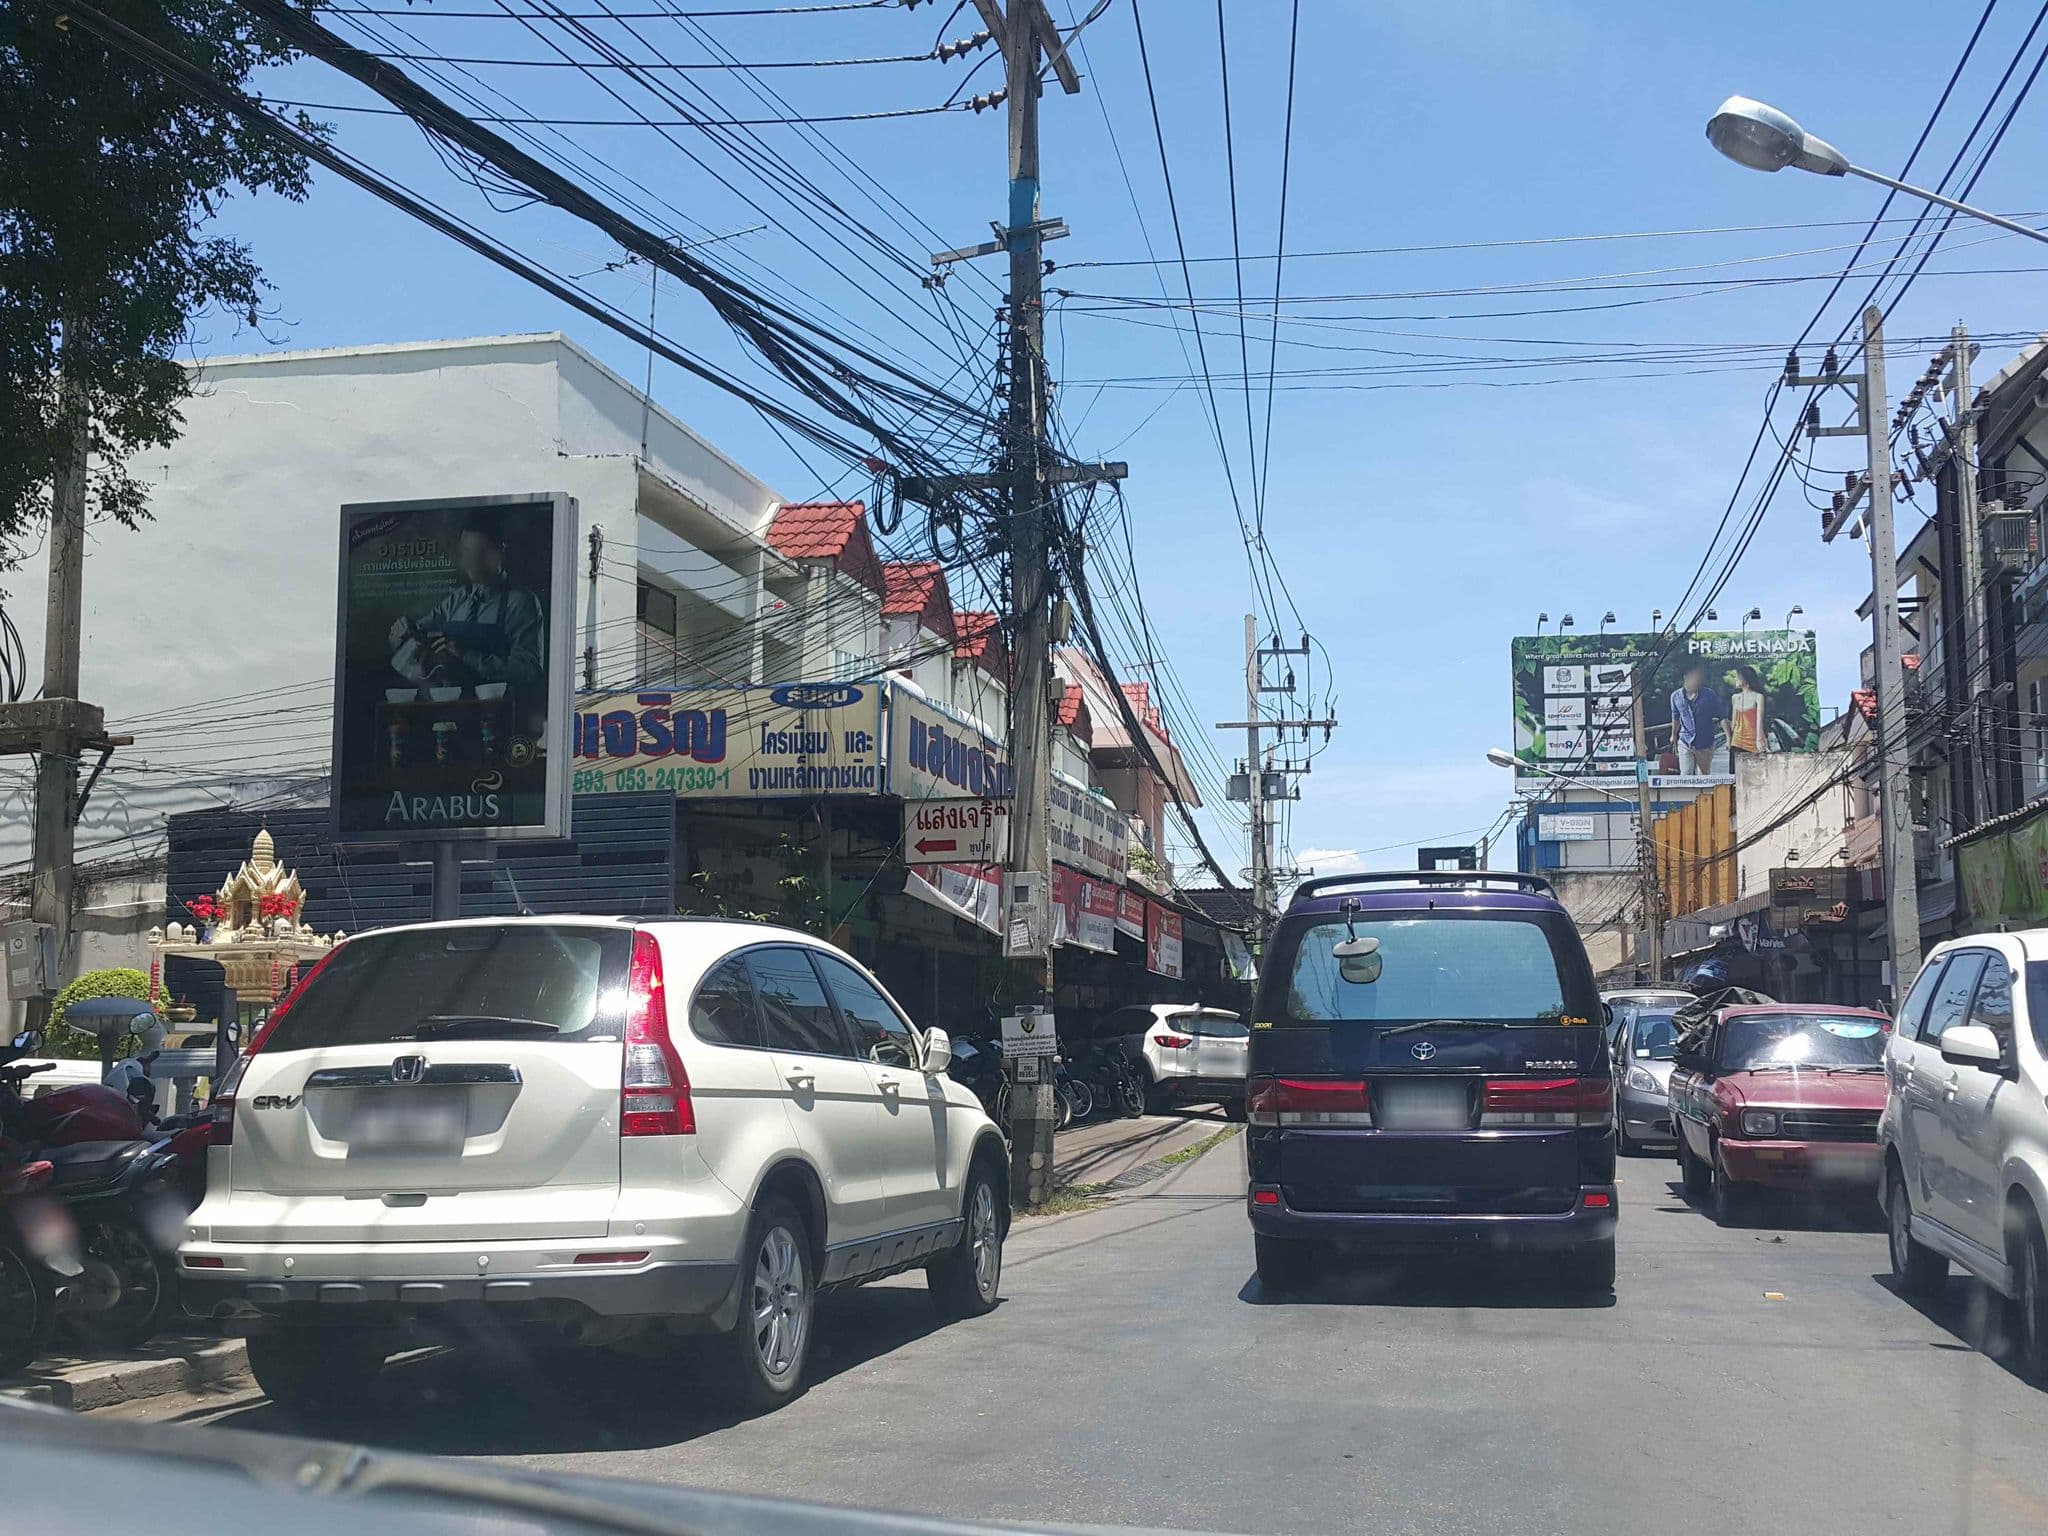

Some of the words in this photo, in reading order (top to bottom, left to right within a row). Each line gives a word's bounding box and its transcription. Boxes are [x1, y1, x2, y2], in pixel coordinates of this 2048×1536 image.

[845, 730, 873, 753] และ
[615, 767, 730, 791] 053-247330-1
[384, 790, 501, 822] ARABUS
